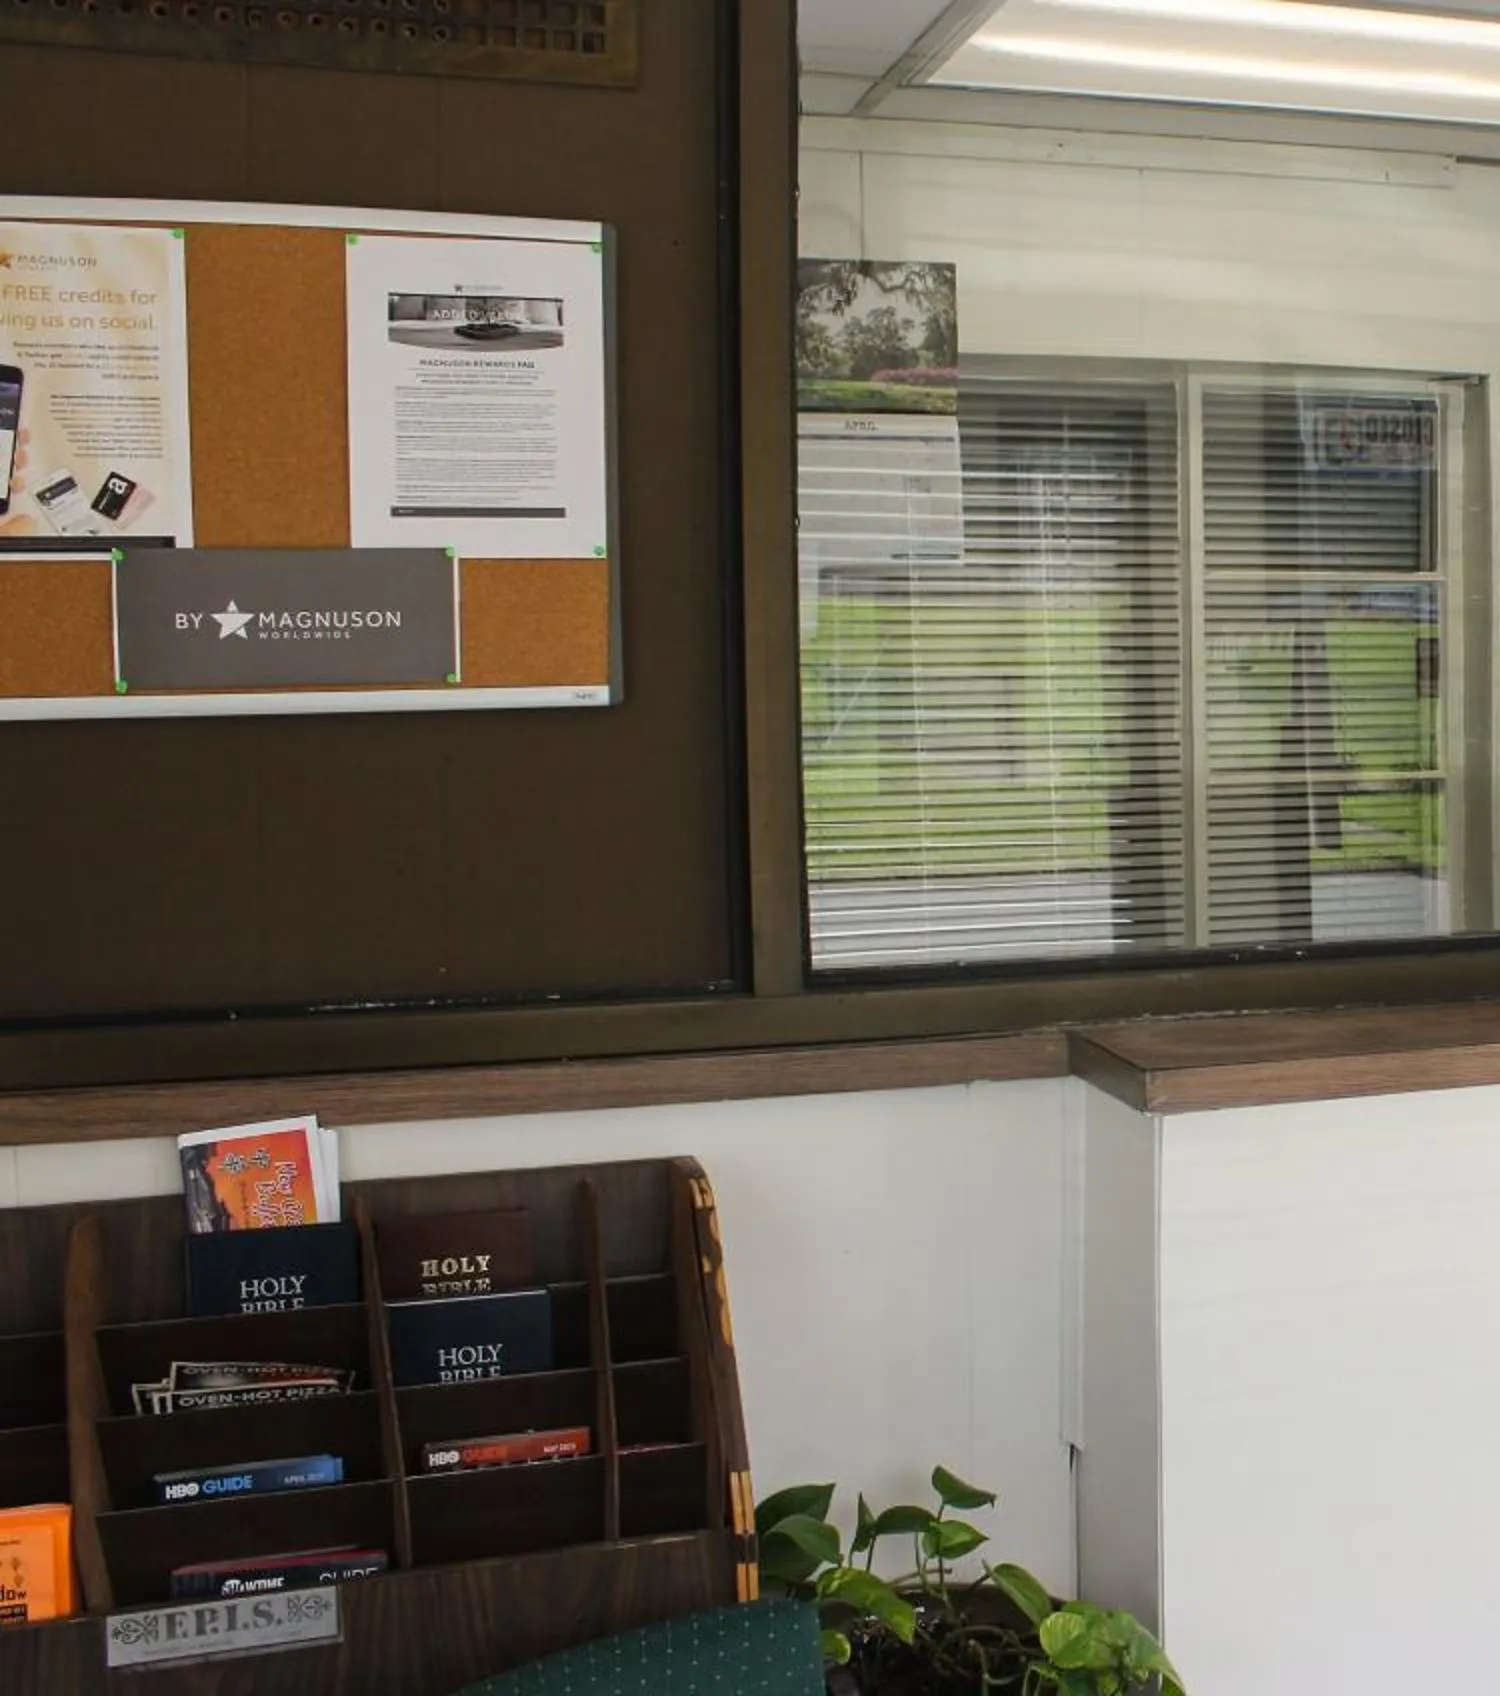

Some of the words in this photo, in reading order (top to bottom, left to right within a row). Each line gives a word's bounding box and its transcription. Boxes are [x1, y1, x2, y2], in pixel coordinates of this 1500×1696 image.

[17, 254, 98, 268] MAGNUSON
[3, 284, 52, 302] FREE
[58, 289, 126, 304] credits
[130, 289, 158, 305] for
[42, 315, 64, 328] us
[69, 316, 94, 329] on
[845, 420, 878, 431] APRIL
[175, 613, 203, 629] BY
[258, 611, 402, 629] MAGNUSON
[259, 631, 352, 640] WORLDWIDE
[421, 1254, 491, 1277] HOLY
[240, 1274, 306, 1299] HOLY
[438, 1343, 503, 1367] HOLY
[178, 1388, 282, 1408] OVEN-HOT
[285, 1384, 342, 1399] PIZZA
[428, 1450, 461, 1468] HBO
[165, 1481, 200, 1499] HBO
[202, 1474, 253, 1494] GUIDE
[164, 1600, 283, 1641] E.P.I.S.
